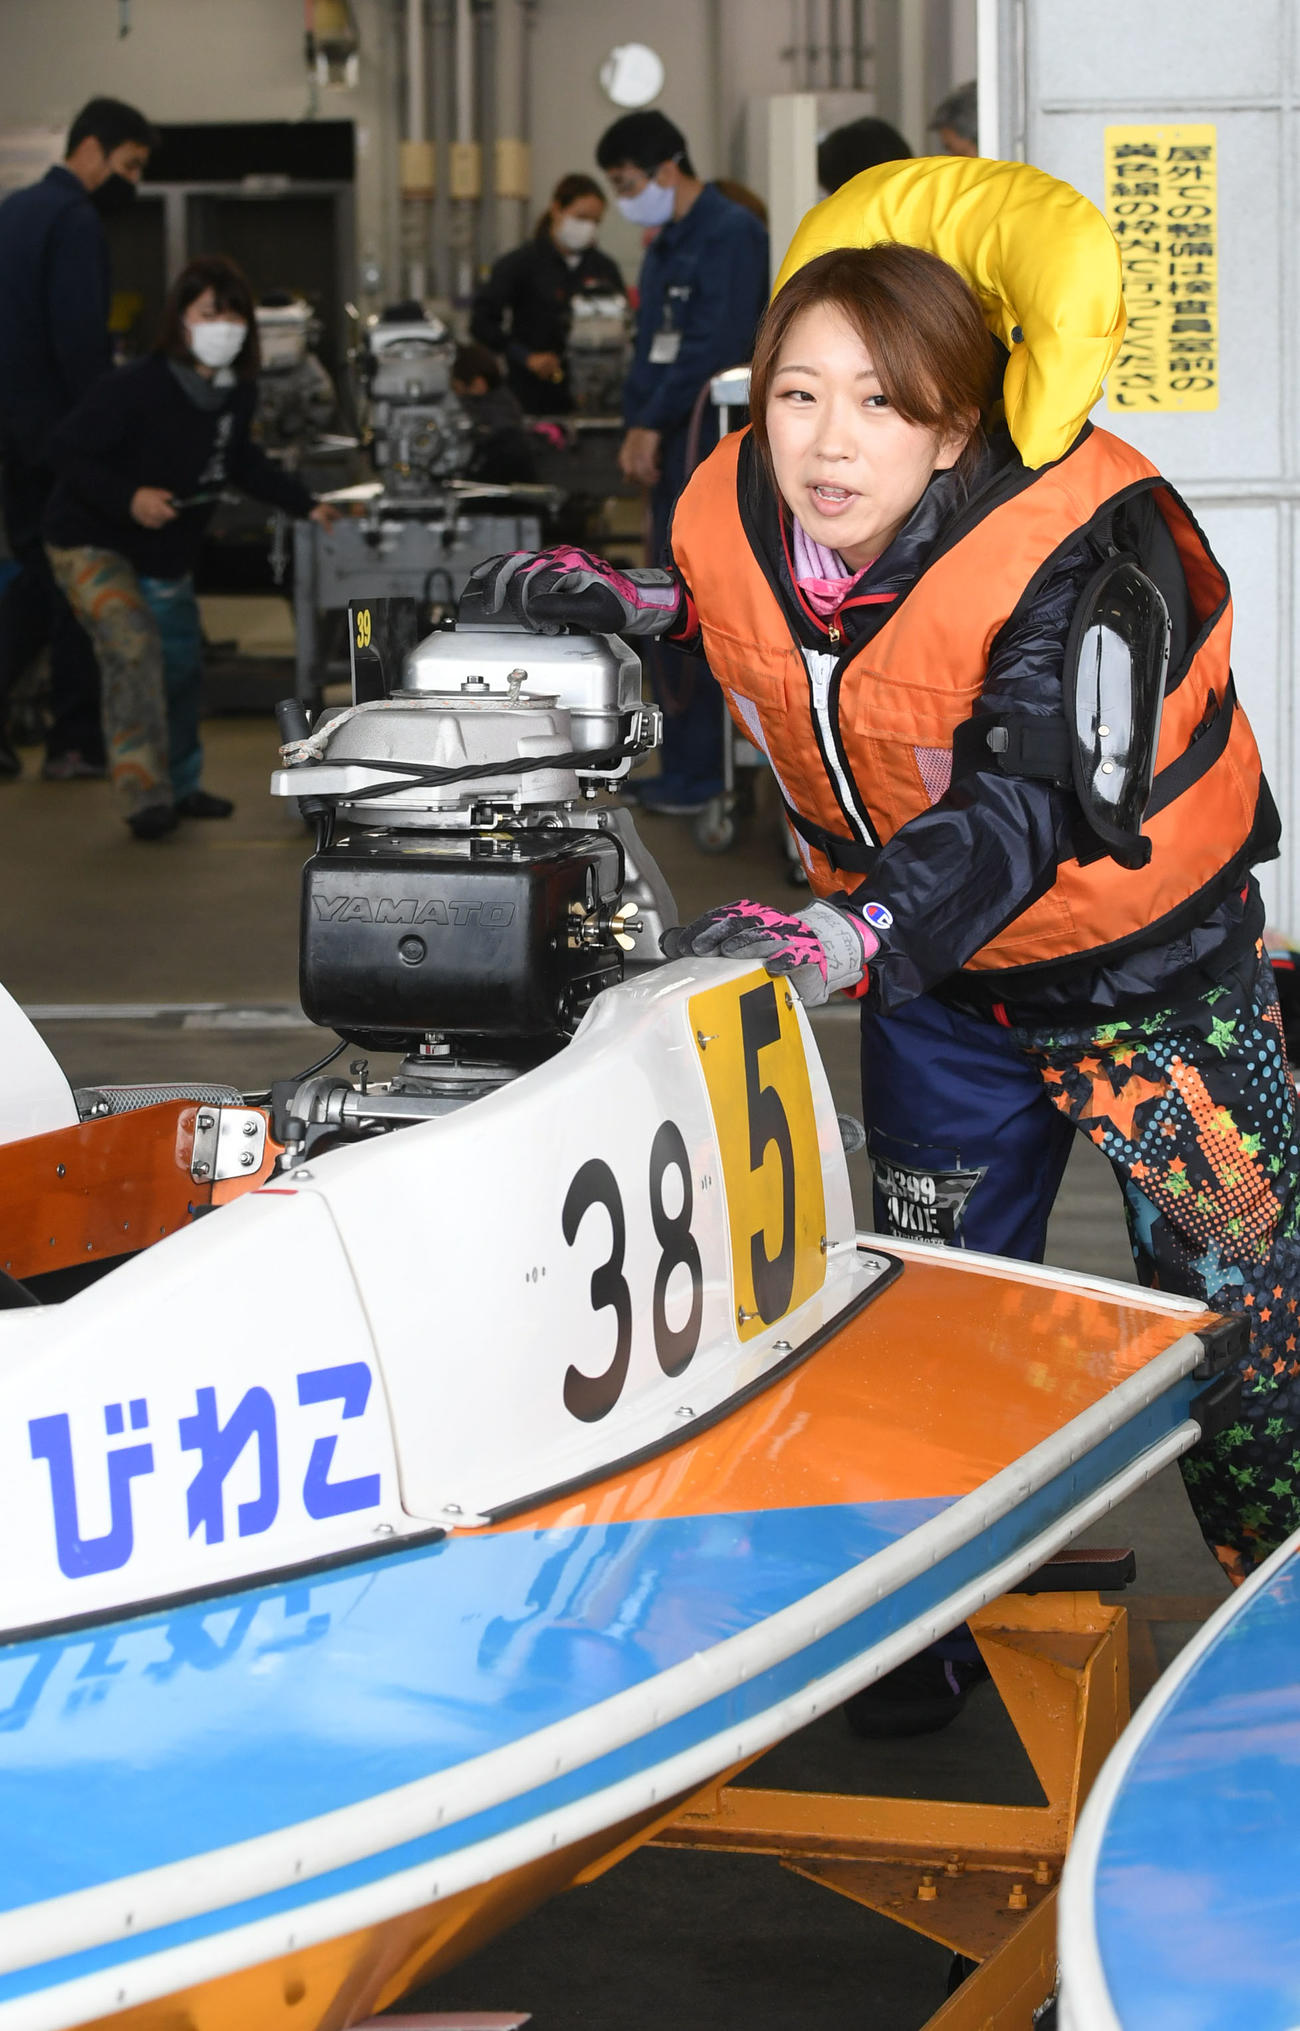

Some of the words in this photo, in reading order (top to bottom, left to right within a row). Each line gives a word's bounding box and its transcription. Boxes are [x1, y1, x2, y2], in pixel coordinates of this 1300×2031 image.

[357, 608, 372, 649] 39
[312, 895, 516, 928] YAMATO
[739, 981, 796, 1325] 5
[562, 1120, 703, 1423] 38
[28, 1361, 381, 1580] びわこ
